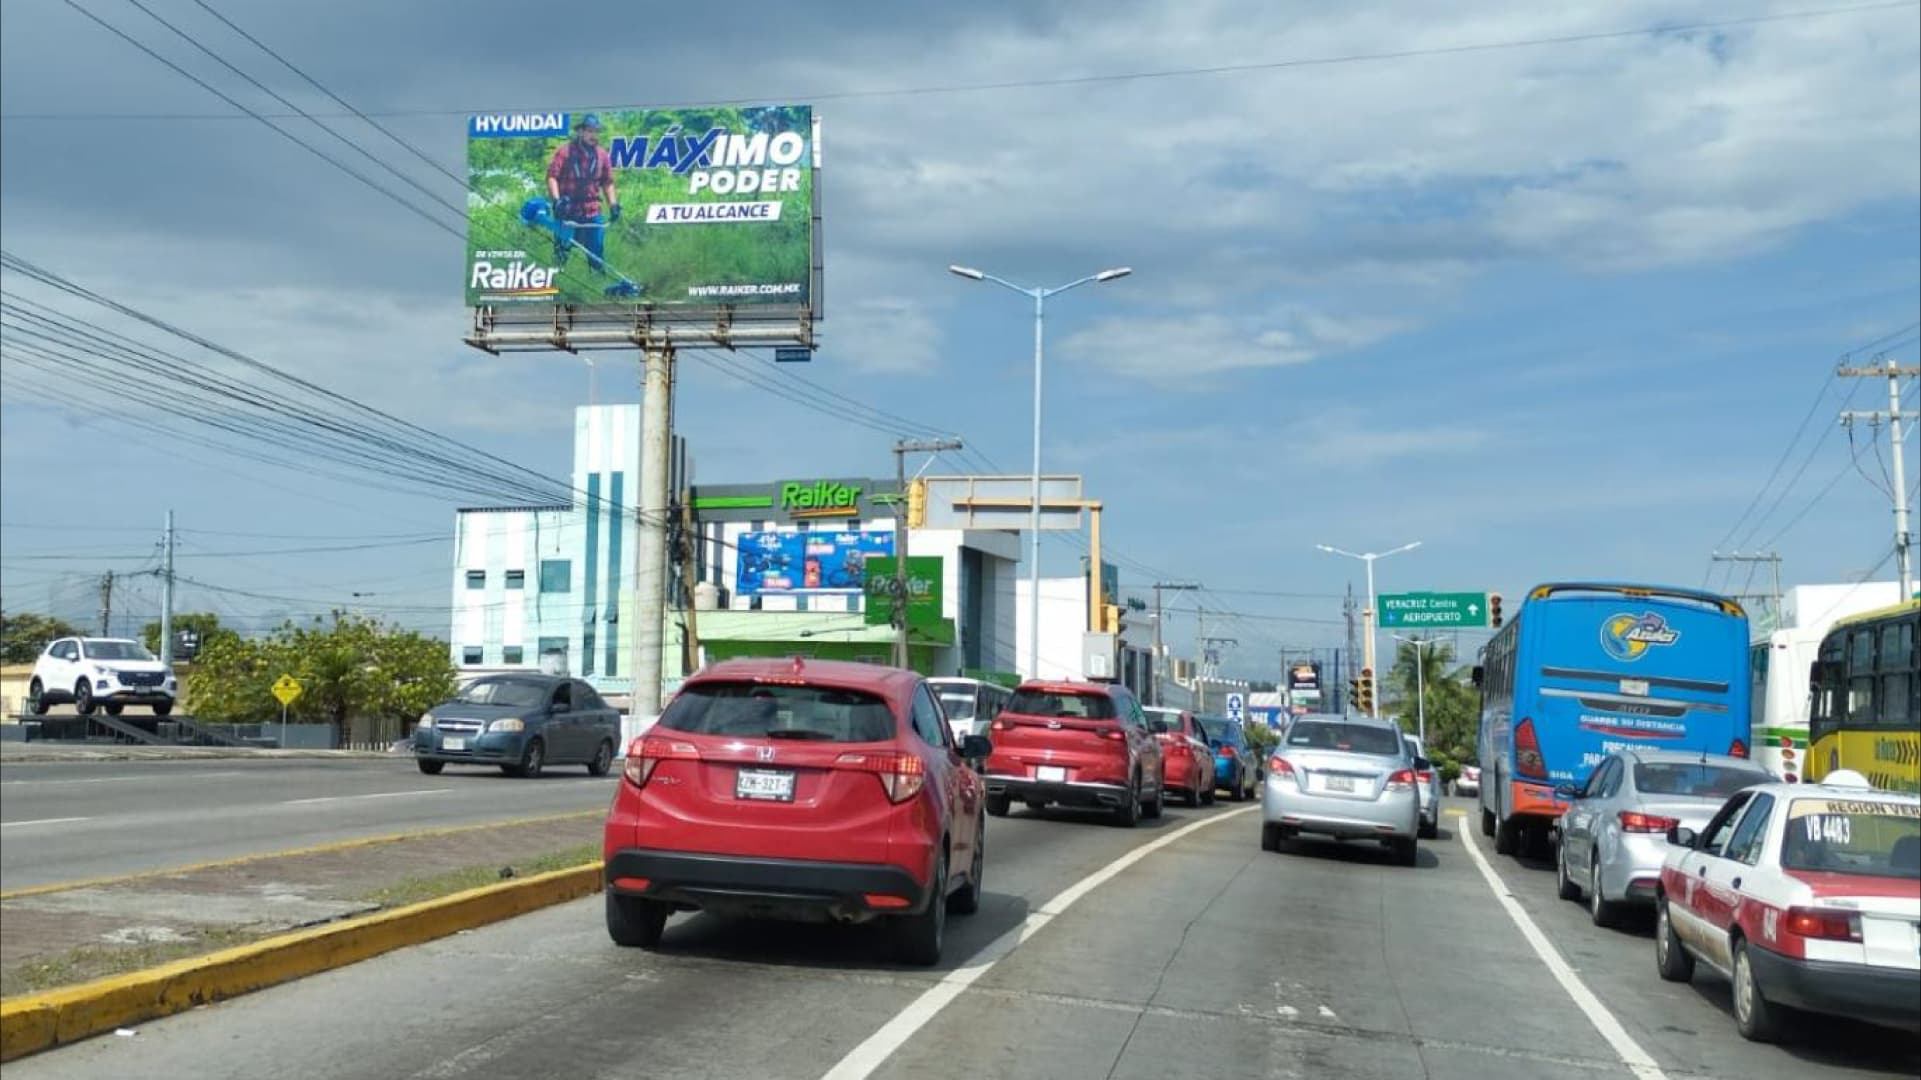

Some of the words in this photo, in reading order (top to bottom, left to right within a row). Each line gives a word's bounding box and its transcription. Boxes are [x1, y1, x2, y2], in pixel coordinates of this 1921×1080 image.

[476, 113, 563, 132] HYUNDAI
[609, 125, 804, 174] MÁXIMO
[689, 168, 801, 195] PODER
[656, 206, 668, 220] A
[671, 205, 692, 220] TU
[695, 203, 770, 220] ALCANCE
[471, 260, 559, 289] Raiker
[688, 283, 801, 297] WWW.RAIKER.COM.MX
[782, 480, 863, 509] Raiker
[1385, 598, 1427, 609] VERACRUZ
[1429, 598, 1458, 608] Centro
[1403, 611, 1462, 622] AEROPUERTO
[1638, 718, 1686, 732] DISTANCIA
[1826, 801, 1886, 815] REGION
[1806, 815, 1822, 841] VB
